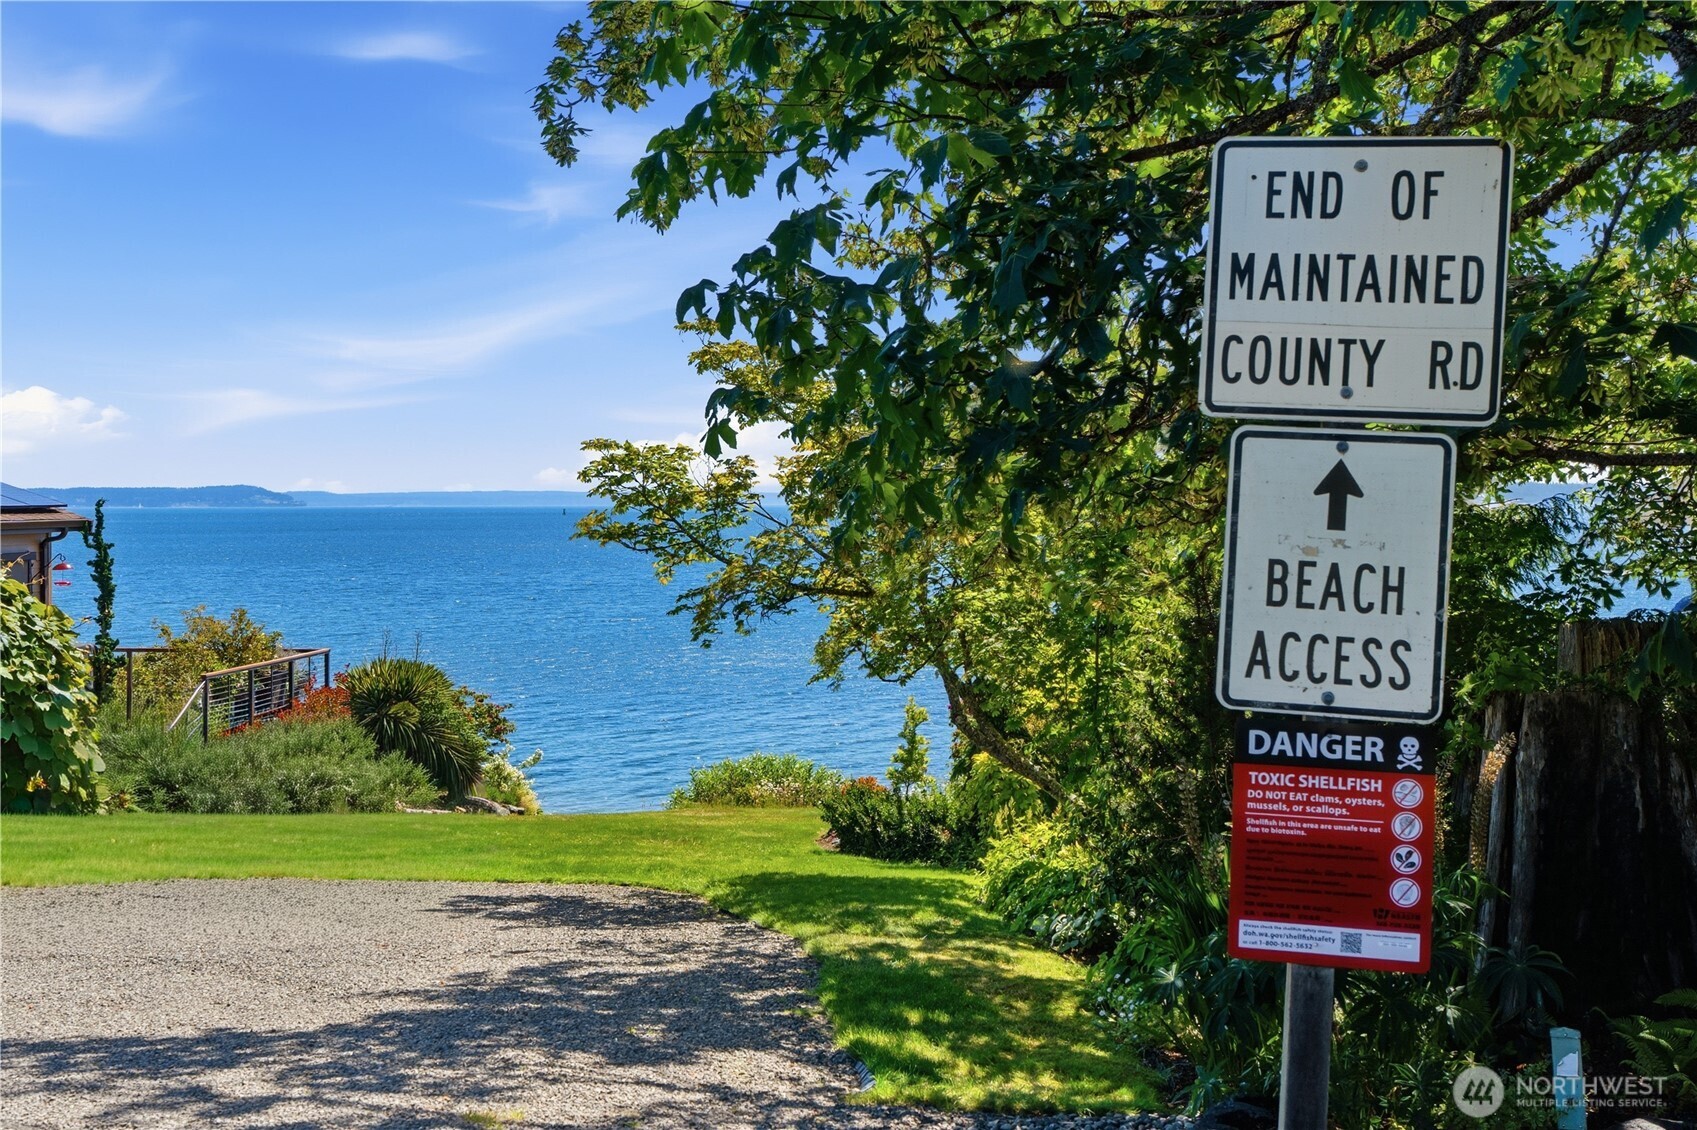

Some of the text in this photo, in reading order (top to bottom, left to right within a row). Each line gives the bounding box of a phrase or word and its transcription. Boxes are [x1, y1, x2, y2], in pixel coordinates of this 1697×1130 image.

[1265, 170, 1445, 220] END OF
[1228, 252, 1485, 305] MAINTAINED
[1221, 334, 1386, 387] COUNTY
[1265, 558, 1405, 616] BEACH
[1244, 630, 1412, 691] ACCESS
[1248, 729, 1385, 763] DANGER
[1249, 771, 1382, 792] TOXIC SHELLFISH
[1247, 789, 1385, 807] DO NOT EAT clams, oysters,
[1247, 801, 1350, 816] mussels, or scallops.
[1246, 817, 1277, 827] Shellfish
[1287, 820, 1301, 828] this
[1333, 824, 1358, 832] unsafe
[1246, 825, 1260, 833] due
[1270, 827, 1307, 836] biotoxins.
[1243, 930, 1336, 944] doh.wa.gov/shellfishsafety
